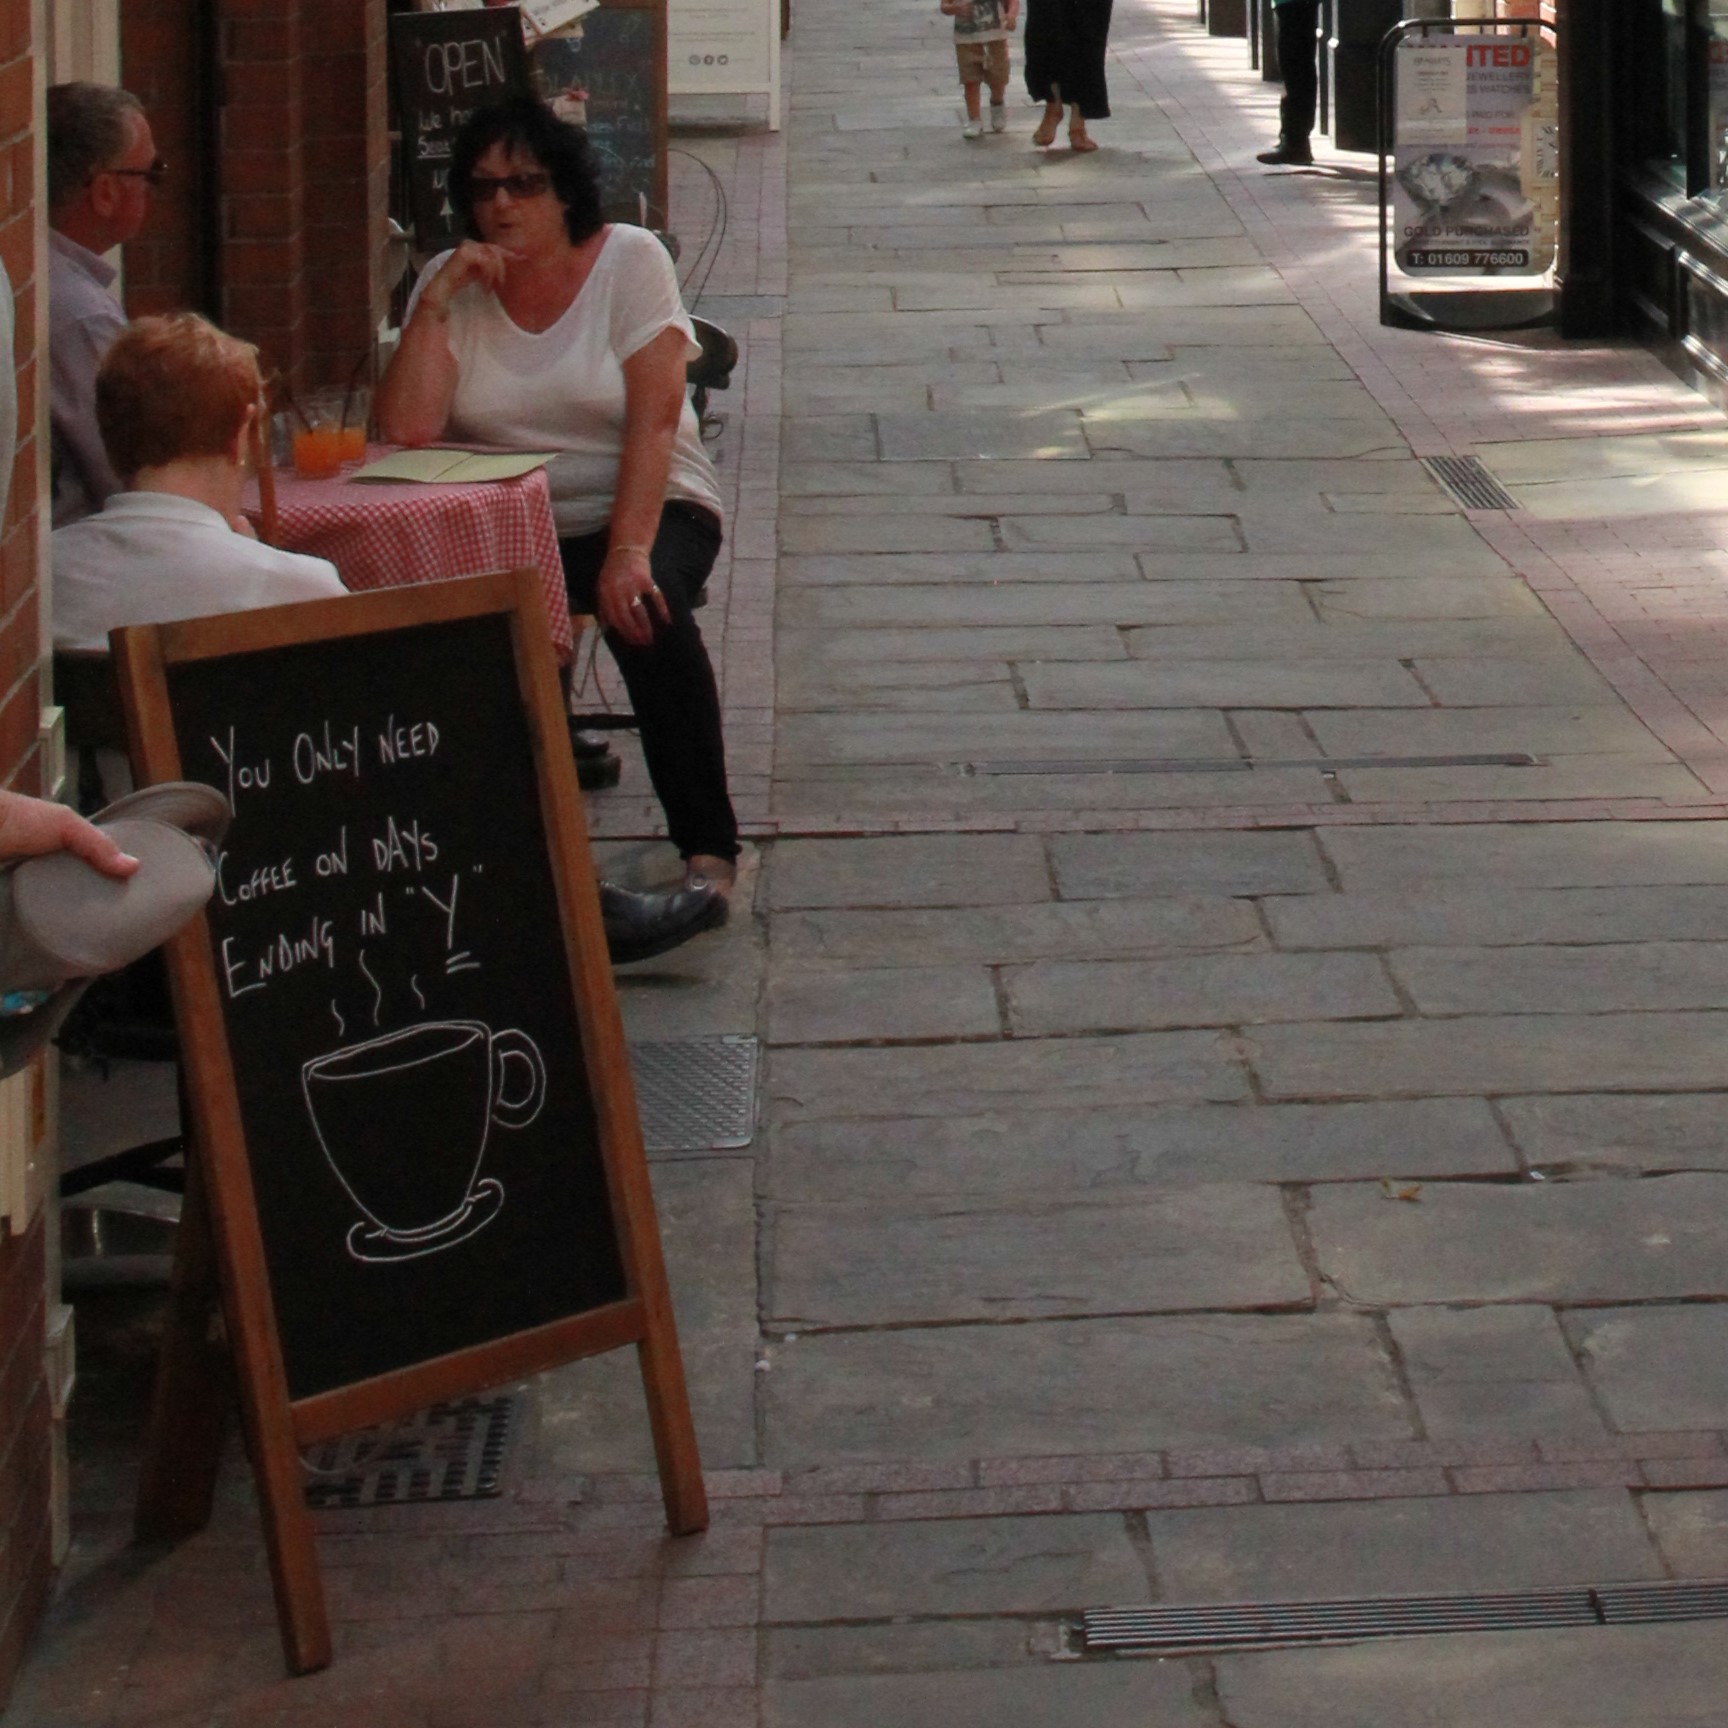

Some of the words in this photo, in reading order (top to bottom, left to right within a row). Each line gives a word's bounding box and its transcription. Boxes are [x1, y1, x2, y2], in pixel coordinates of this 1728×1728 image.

[1404, 225, 1442, 238] GOLD
[1446, 224, 1530, 237] PURCHASED
[1412, 253, 1424, 264] T:
[1428, 253, 1469, 265] 01609
[1474, 253, 1524, 265] 776600
